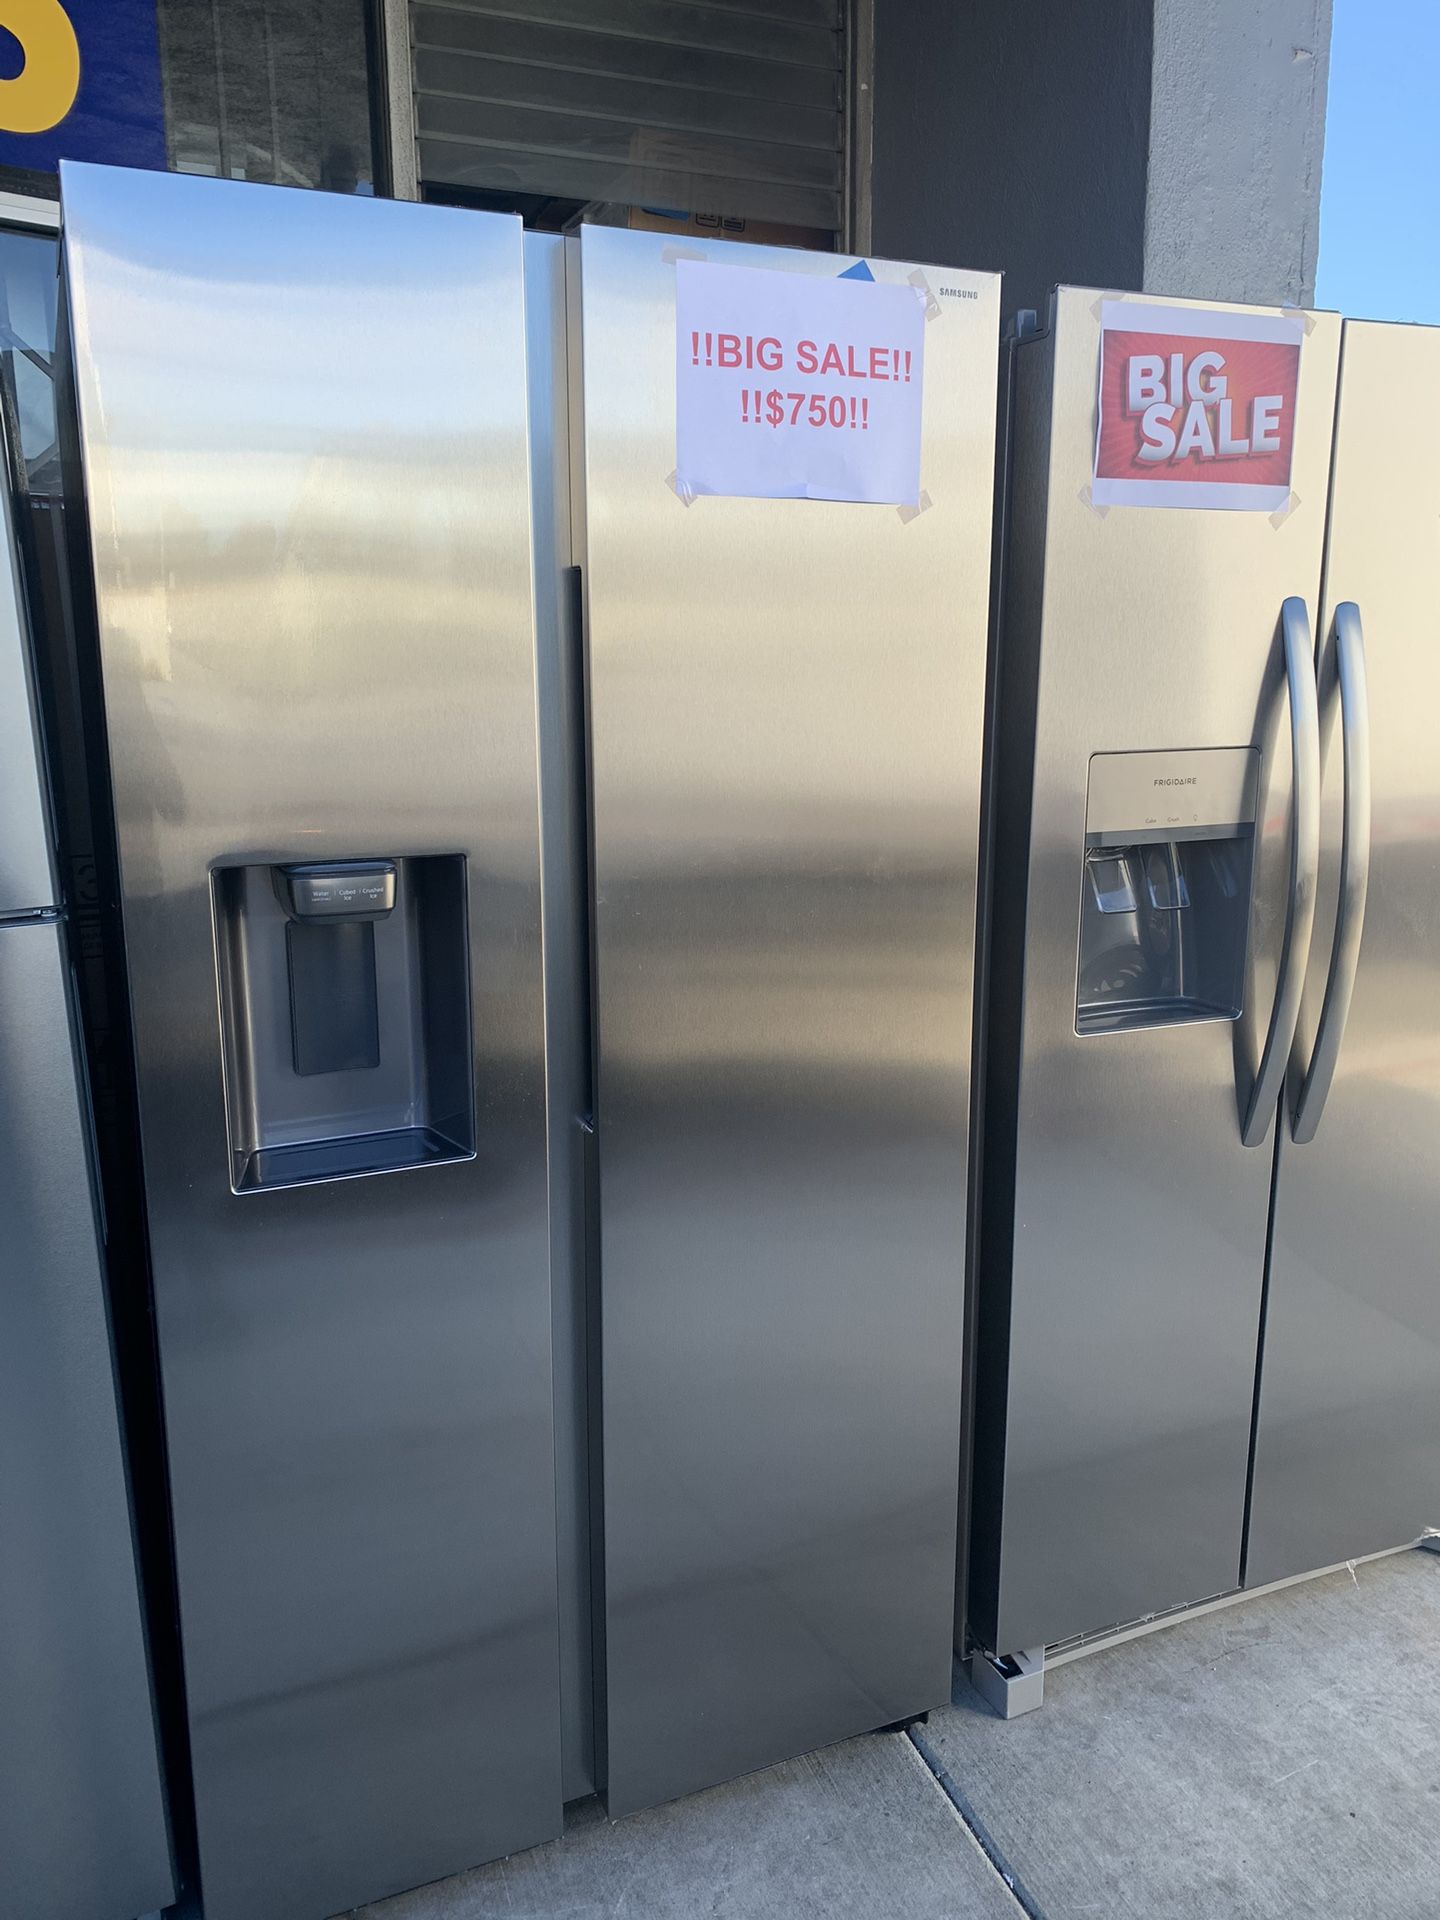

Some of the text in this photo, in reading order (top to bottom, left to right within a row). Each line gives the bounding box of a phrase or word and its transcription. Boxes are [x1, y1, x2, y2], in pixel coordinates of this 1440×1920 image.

[939, 287, 978, 300] SAMSUNG
[691, 331, 912, 382] !!BIG SALE!!
[1128, 351, 1228, 411] BIG
[741, 389, 869, 430] !!$750!!
[1138, 395, 1284, 461] SALE
[1153, 777, 1197, 786] FRIGIDAIRE
